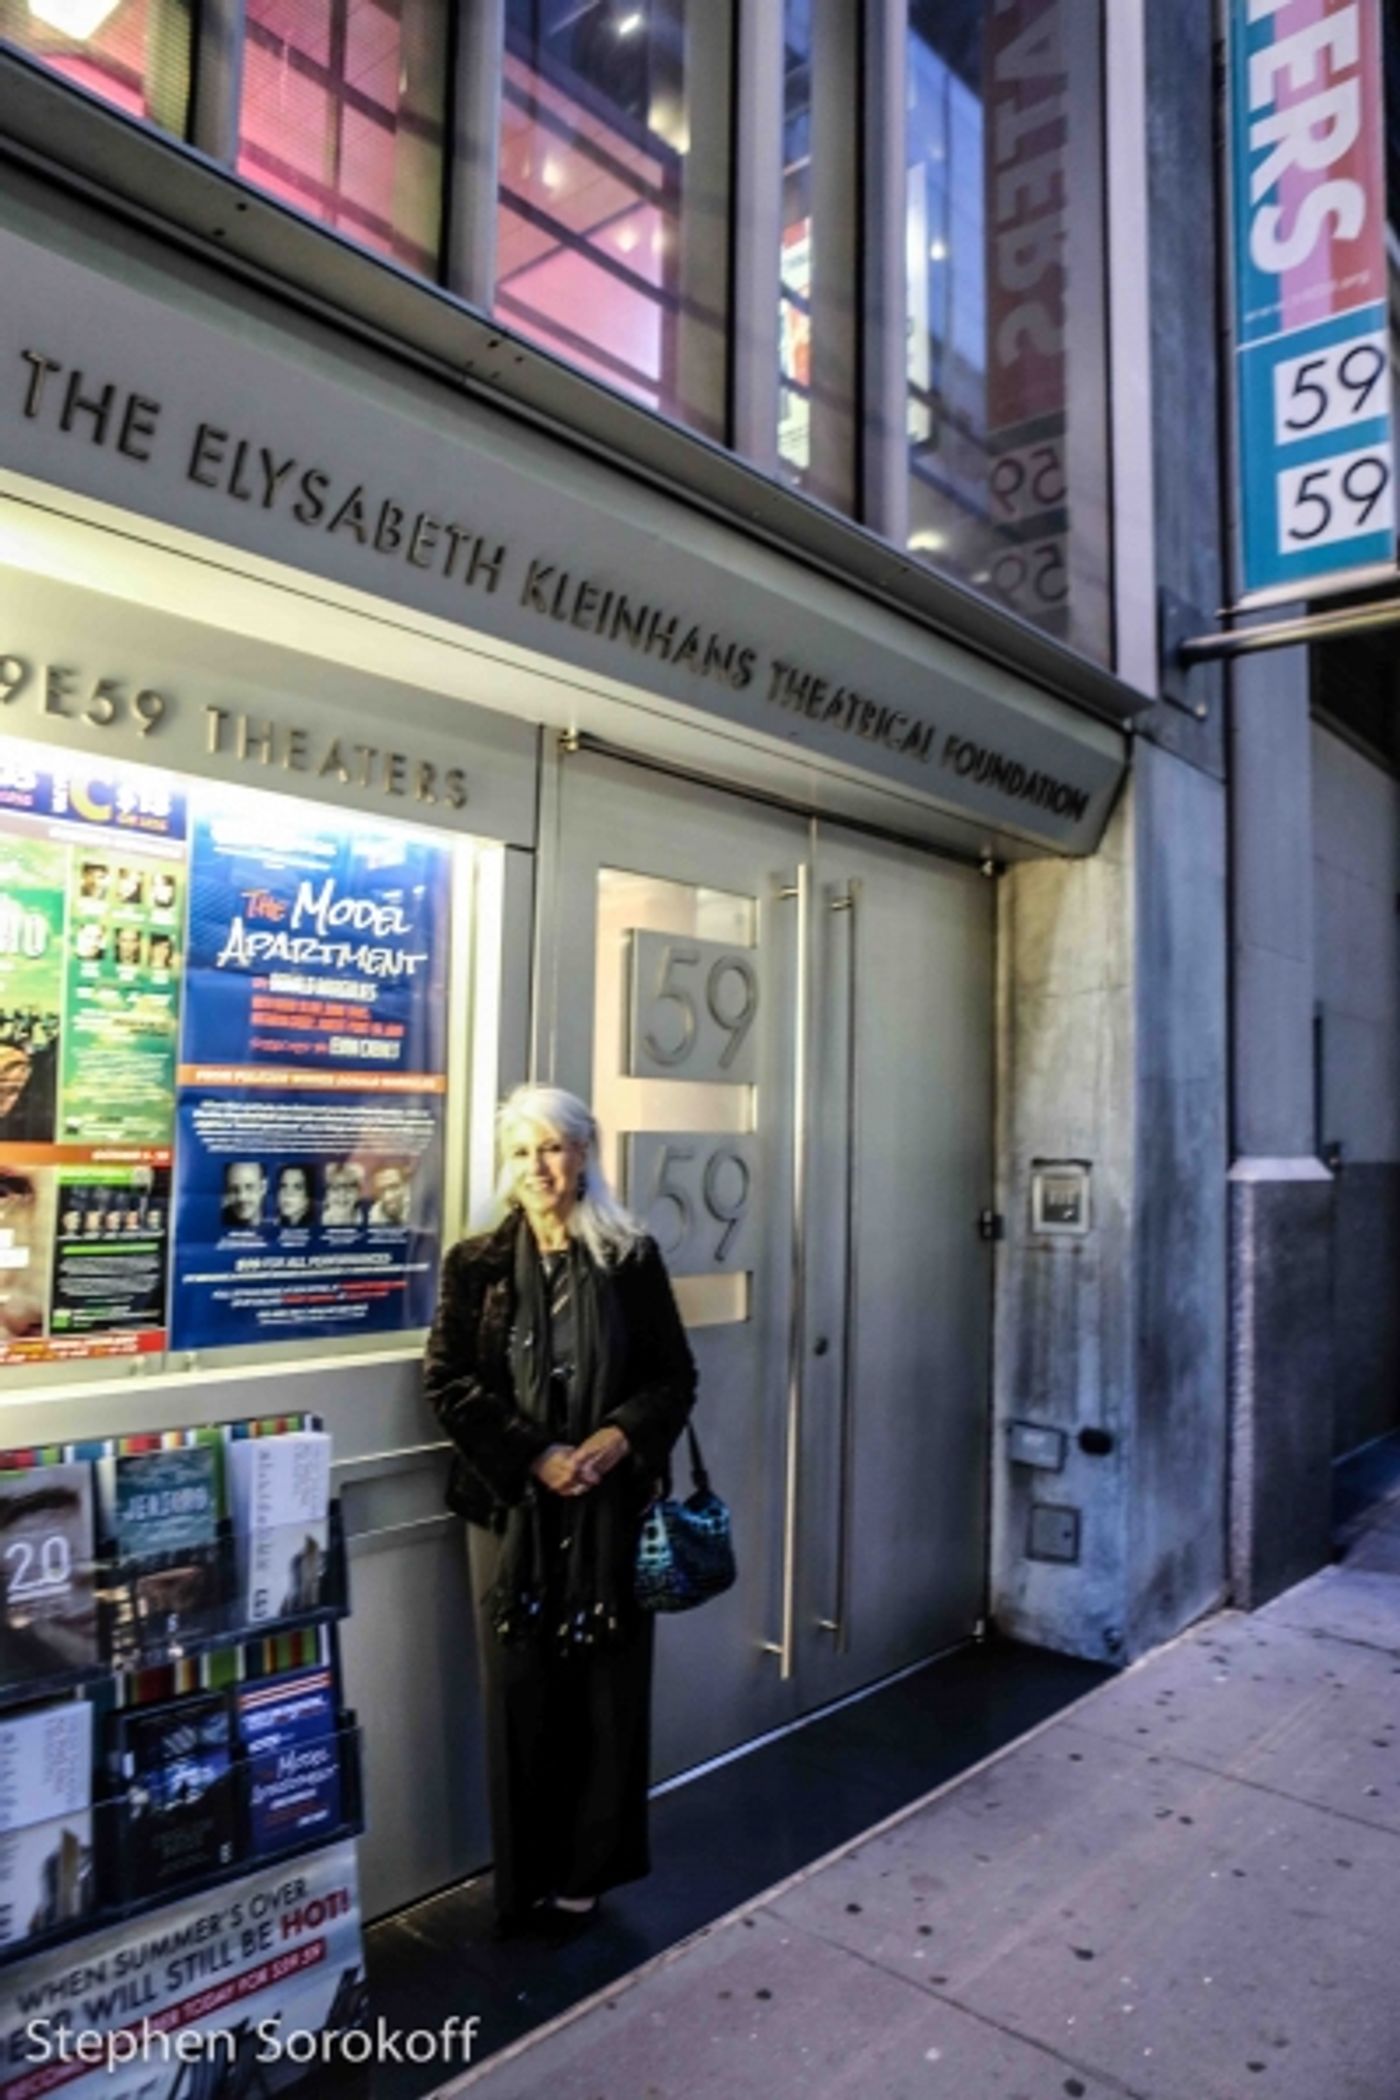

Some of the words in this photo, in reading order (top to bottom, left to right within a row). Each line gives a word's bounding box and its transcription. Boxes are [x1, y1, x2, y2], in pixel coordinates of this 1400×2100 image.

[1248, 0, 1367, 273] ERS
[1283, 343, 1388, 432] 59
[1287, 456, 1391, 542] 59
[19, 349, 162, 464] THE
[187, 420, 506, 595] ELYSABETH
[520, 558, 757, 691] KLEINHANS
[766, 659, 938, 766] THEATRICAL
[941, 734, 1092, 824] FOUNDATION
[201, 703, 473, 810] THEATERS
[216, 916, 429, 977] APARTMENT
[643, 945, 759, 1071] 59
[645, 1144, 752, 1264] 59
[4, 1536, 72, 1594] 20
[16, 1961, 107, 2014] WHEN
[114, 1903, 243, 1977] SUMMER'S
[252, 1877, 307, 1920] OVER
[82, 1972, 158, 2024] WILL
[165, 1939, 233, 1992] STILL
[240, 1921, 273, 1958] BE
[279, 1886, 350, 1941] HOT!
